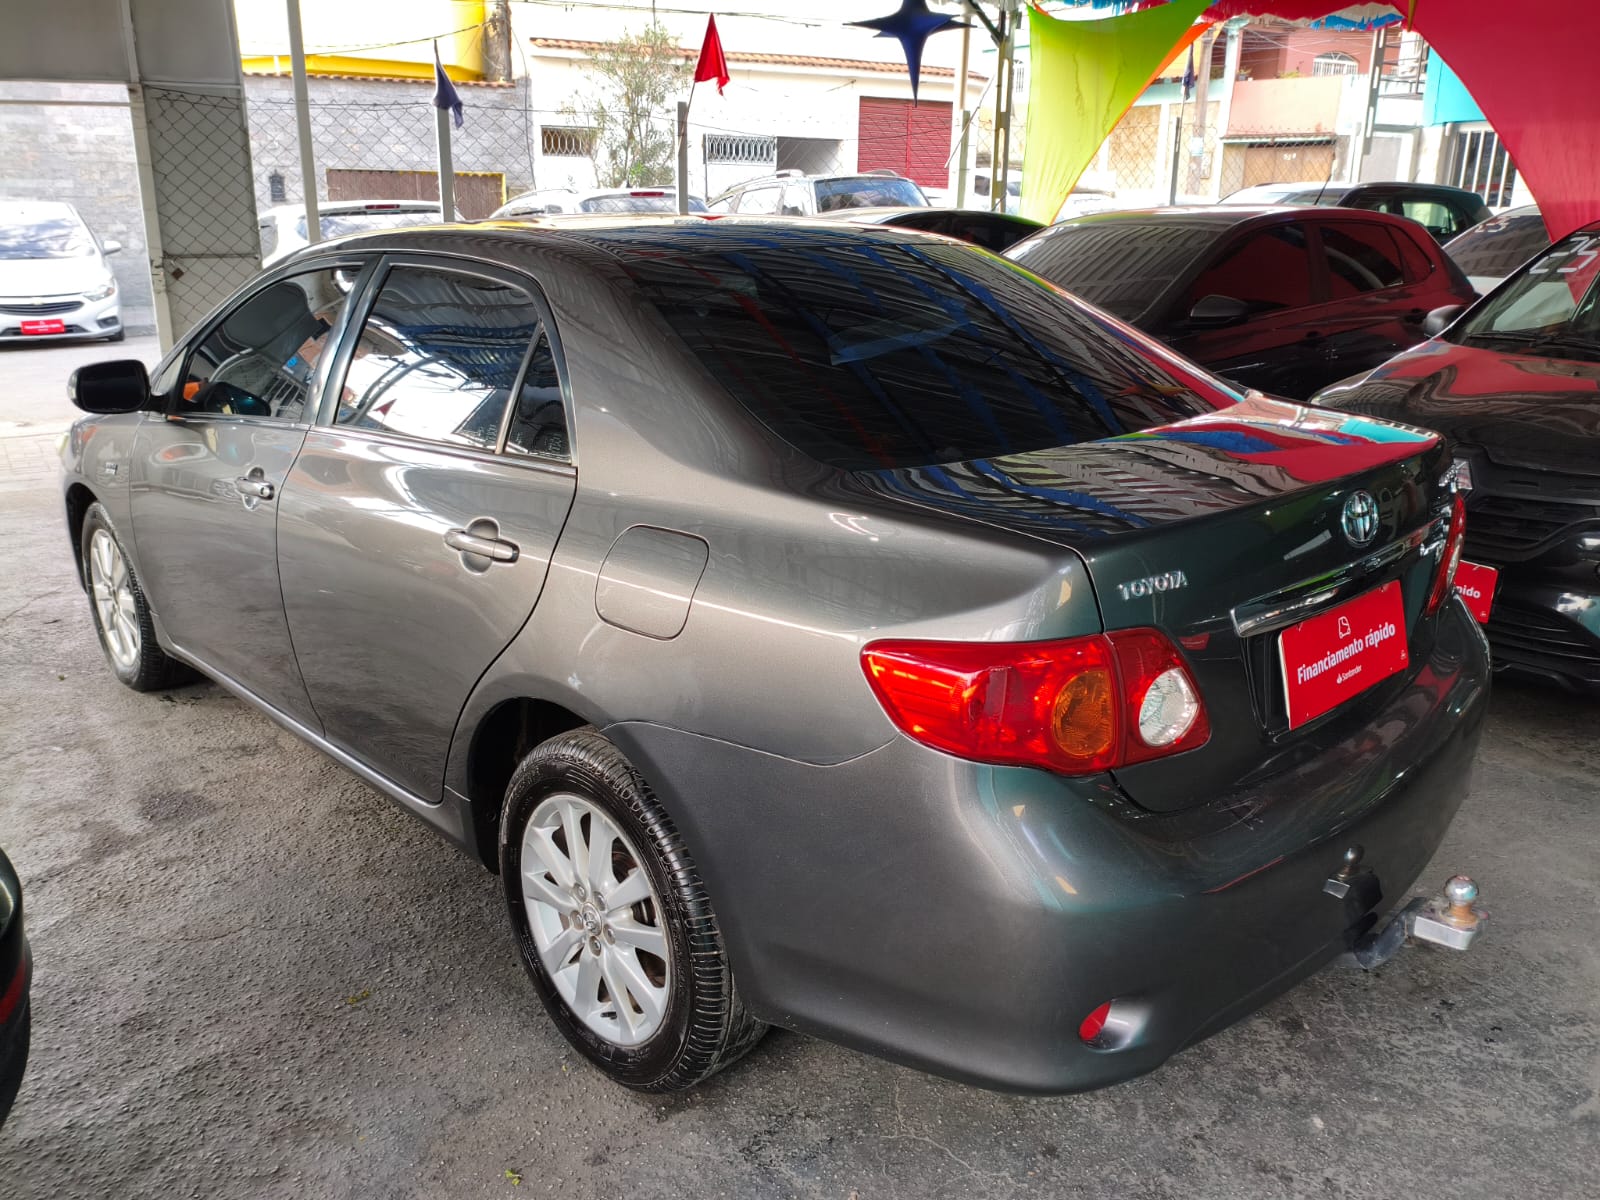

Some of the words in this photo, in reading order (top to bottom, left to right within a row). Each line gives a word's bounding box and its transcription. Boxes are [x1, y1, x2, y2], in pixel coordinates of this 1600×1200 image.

[1117, 570, 1188, 600] TOYOTA
[1297, 638, 1364, 685] Financiamento
[1364, 621, 1396, 648] rápido
[1341, 664, 1362, 682] Santander
